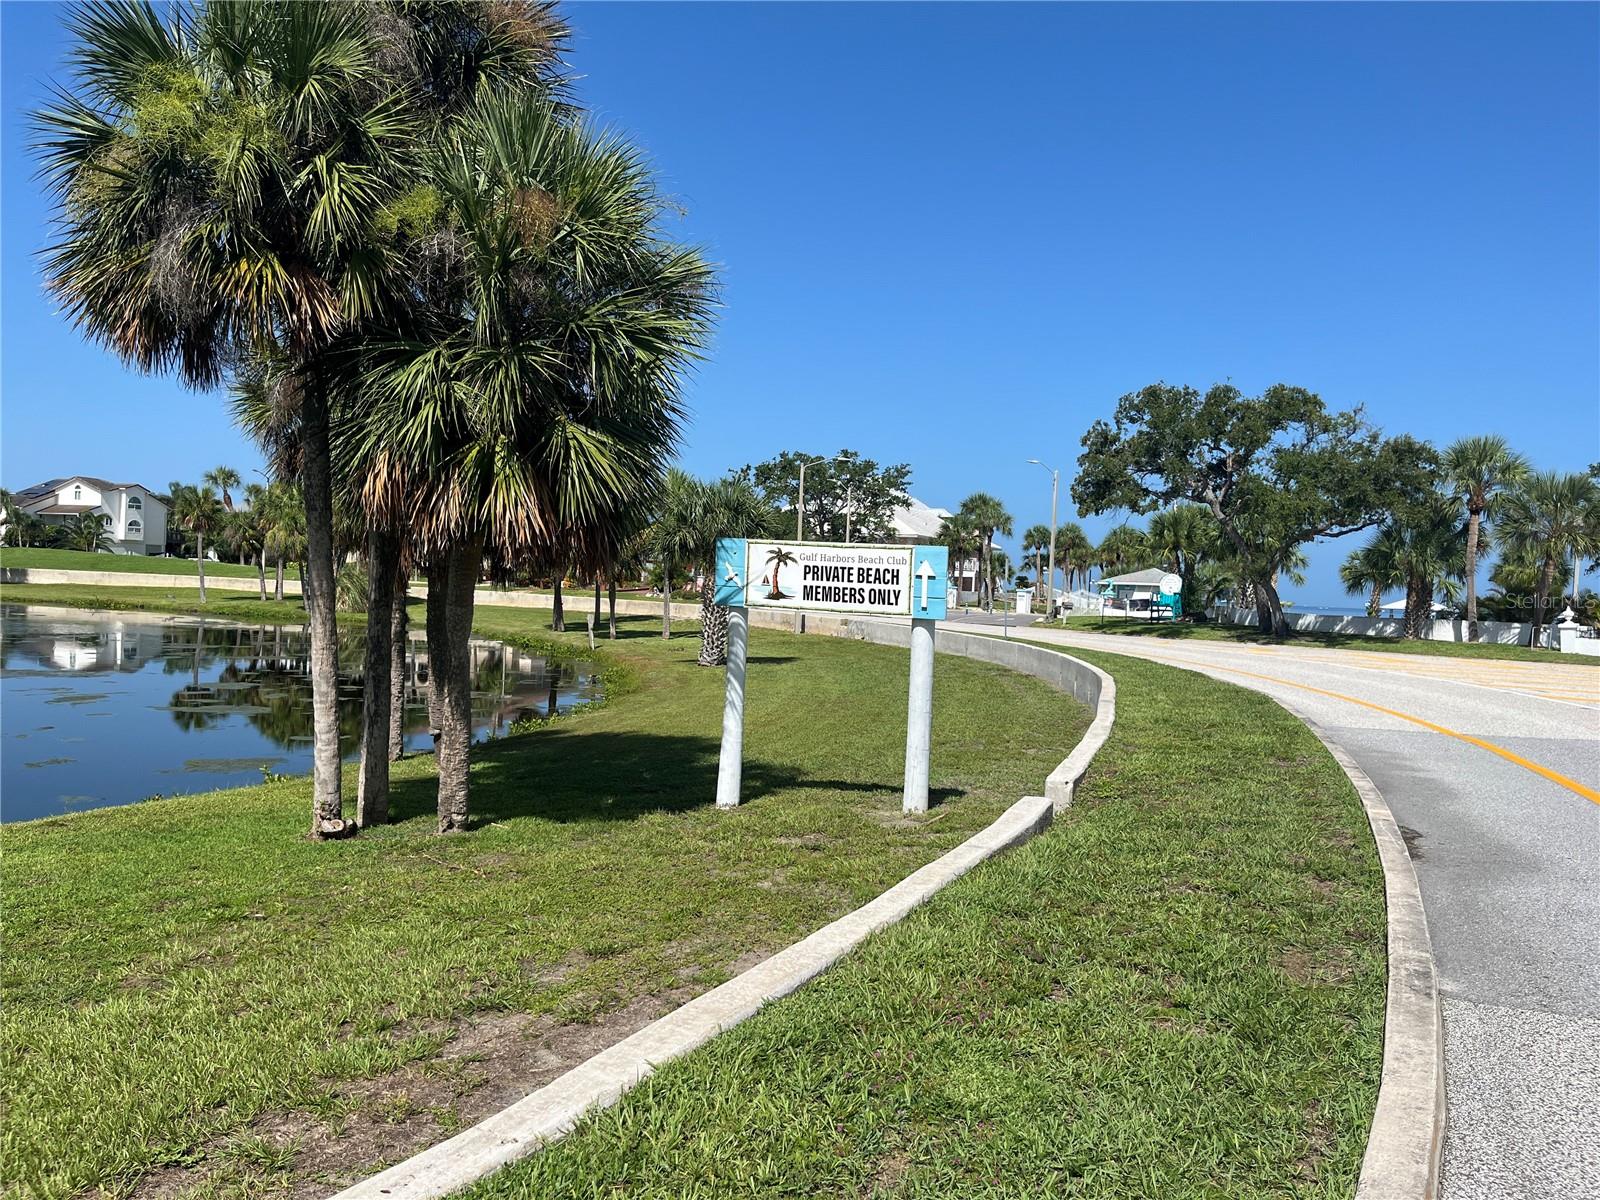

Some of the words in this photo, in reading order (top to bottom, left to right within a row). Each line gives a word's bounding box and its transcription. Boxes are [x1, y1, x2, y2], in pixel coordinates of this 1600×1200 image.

[799, 552, 818, 562] Gulf
[820, 553, 855, 563] Harbors
[858, 555, 884, 565] Beach
[887, 556, 907, 566] Club
[803, 565, 854, 583] PRIVATE
[857, 567, 900, 585] BEACH
[802, 585, 865, 604] MEMBERS
[868, 588, 902, 606] ONLY
